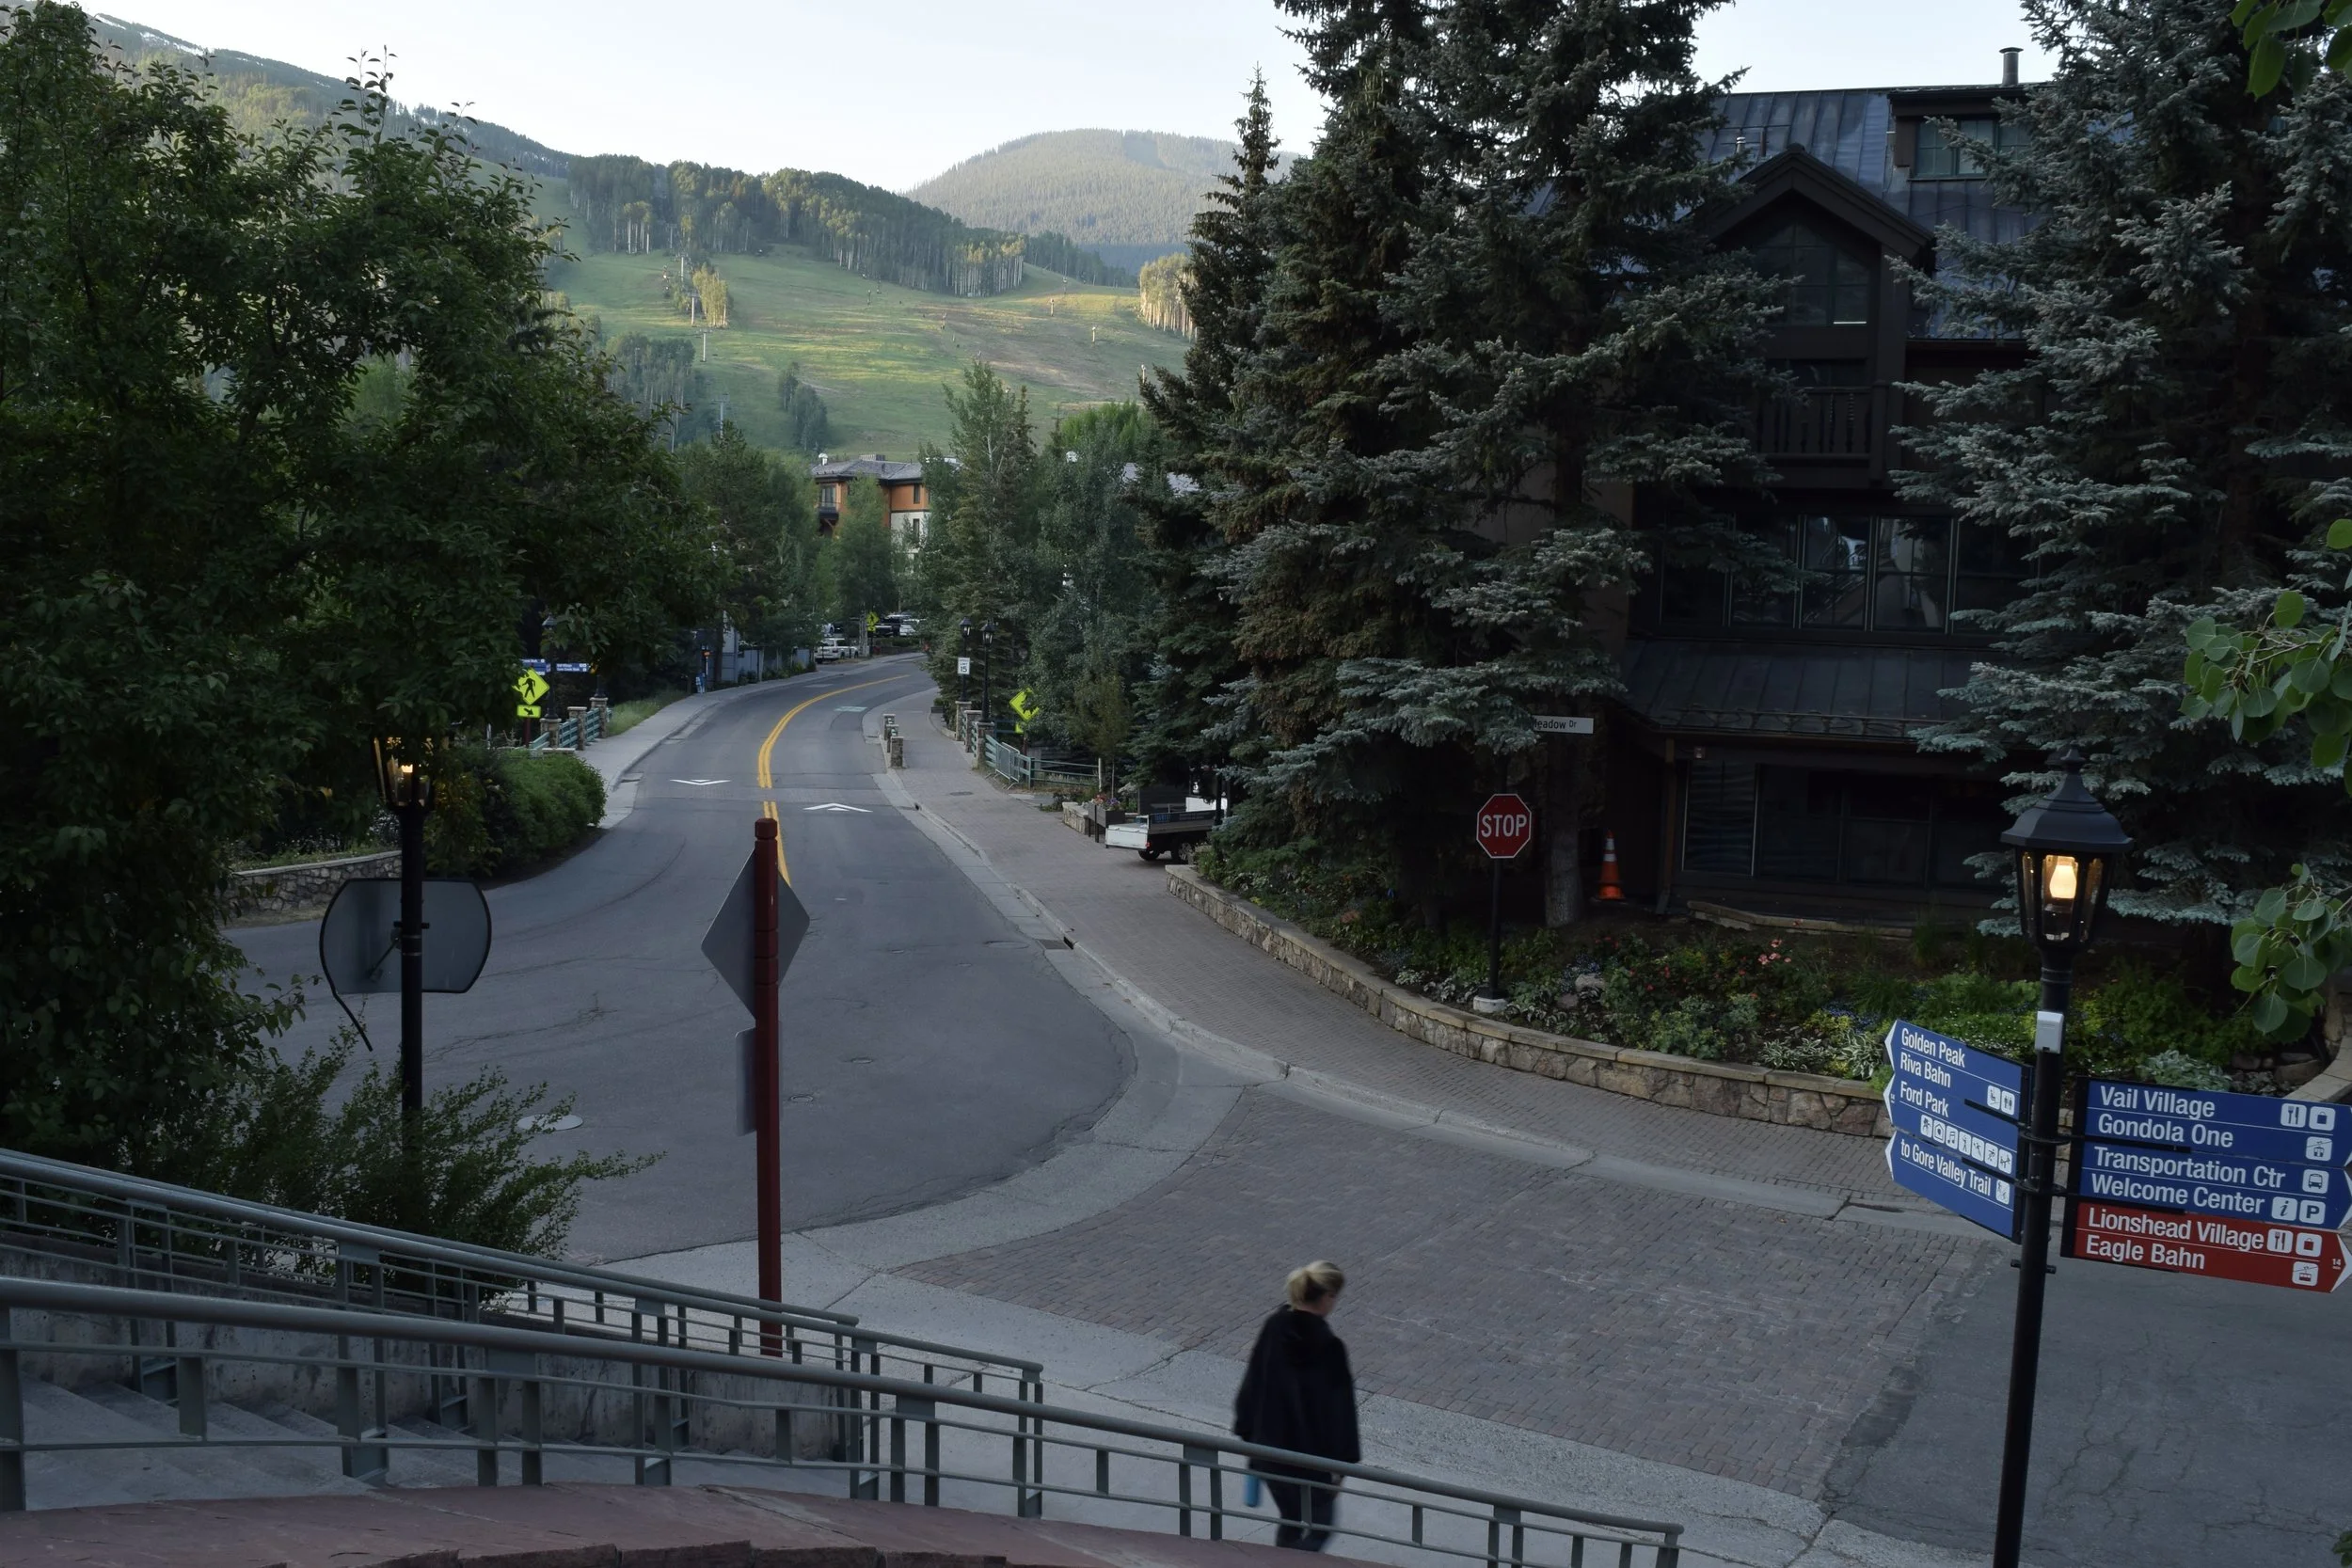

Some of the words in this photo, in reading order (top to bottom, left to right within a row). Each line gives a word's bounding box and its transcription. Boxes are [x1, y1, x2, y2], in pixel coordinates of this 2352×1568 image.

[1568, 720, 1577, 728] Dr
[1481, 814, 1527, 837] STOP
[1901, 1027, 1936, 1057] Golden
[1938, 1040, 1965, 1068] Peak
[1900, 1052, 1922, 1077] Riva
[1924, 1060, 1951, 1088] Bahn
[1900, 1080, 1923, 1106] Ford
[1925, 1090, 1949, 1117] Park
[2100, 1085, 2138, 1109] Vail
[2143, 1089, 2216, 1120] Village
[2098, 1113, 2185, 1143] Gondola
[2191, 1123, 2233, 1148] One
[1900, 1138, 1911, 1158] to
[1912, 1143, 1934, 1170] Gore
[1936, 1154, 1966, 1188] Valley
[1968, 1168, 1992, 1196] Trail
[2094, 1146, 2247, 1184] Transportation
[2253, 1165, 2286, 1189] Ctr
[2091, 1173, 2188, 1205] Welcome
[2193, 1186, 2265, 1214] Center
[2306, 1205, 2320, 1219] P
[2089, 1207, 2192, 1240] Lionshead
[2197, 1221, 2265, 1252] Village
[2086, 1233, 2144, 1262] Eagle
[2151, 1243, 2205, 1270] Bahn
